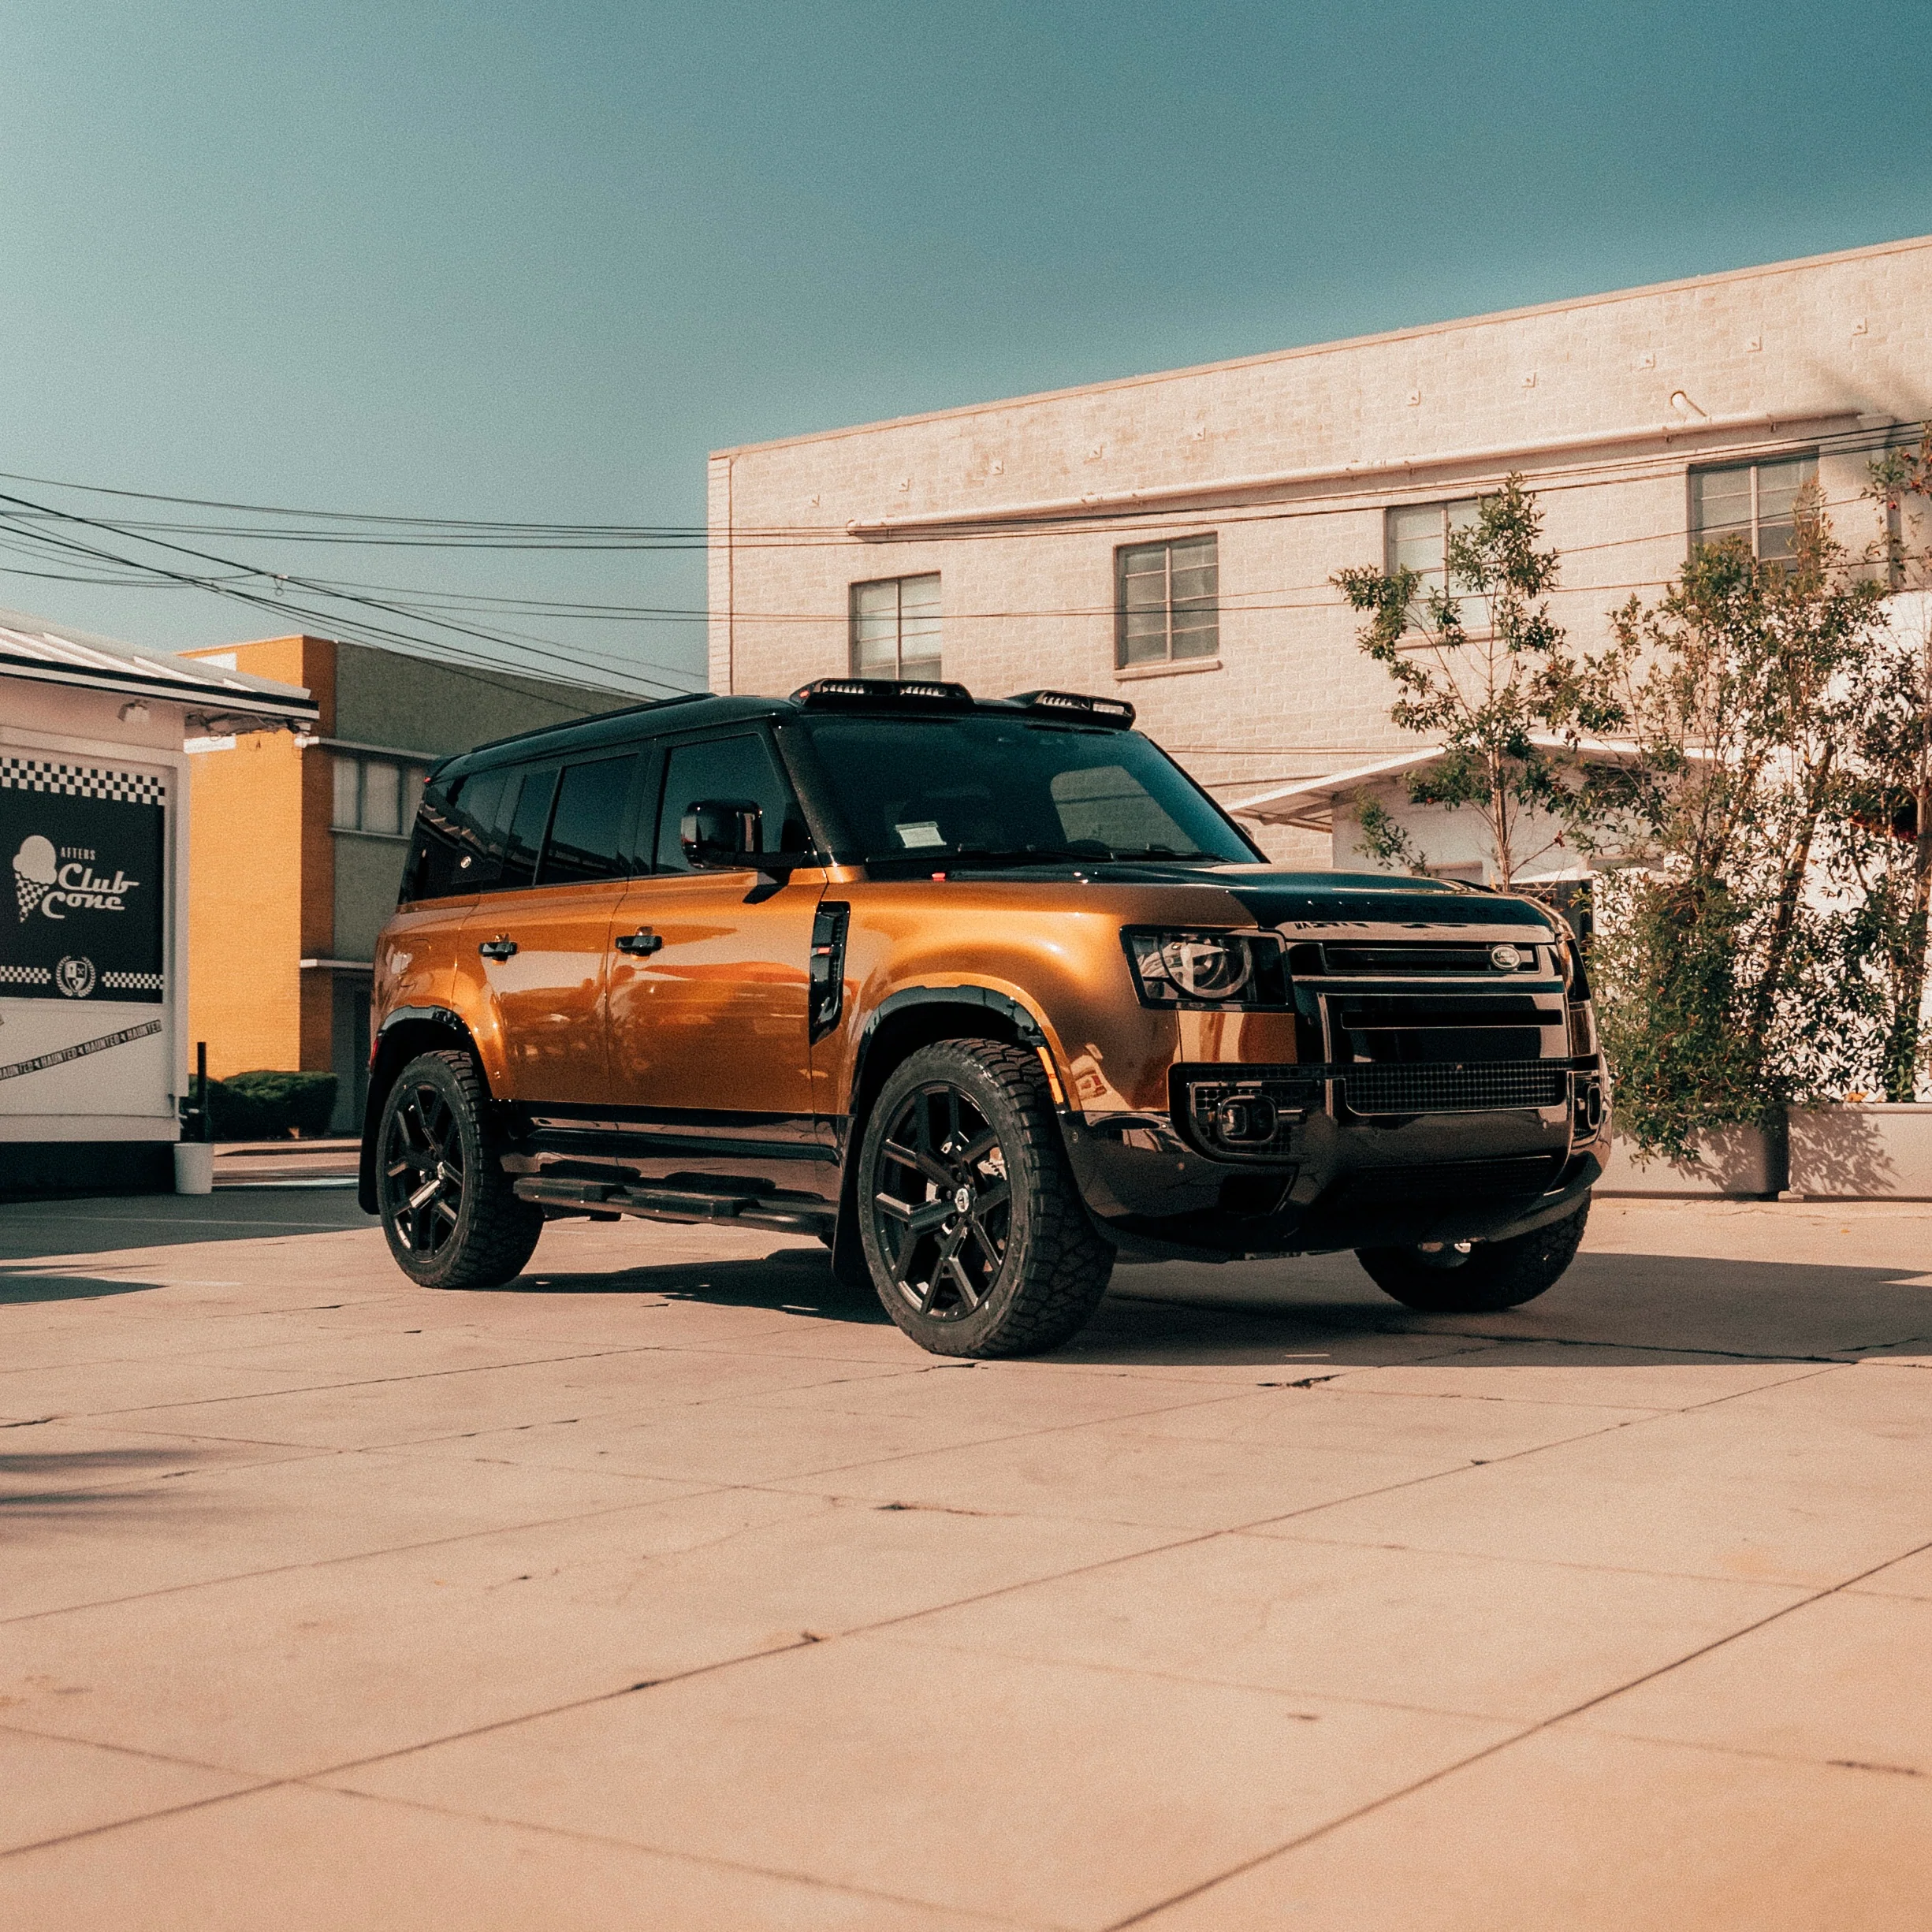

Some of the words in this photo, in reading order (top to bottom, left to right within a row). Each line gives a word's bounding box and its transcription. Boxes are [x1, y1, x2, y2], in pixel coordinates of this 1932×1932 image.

[61, 847, 95, 860] AFTERS
[58, 863, 140, 894] Club
[42, 892, 125, 919] Cone
[41, 1048, 78, 1067] HAUNTED
[84, 1034, 121, 1055] HAUNTED
